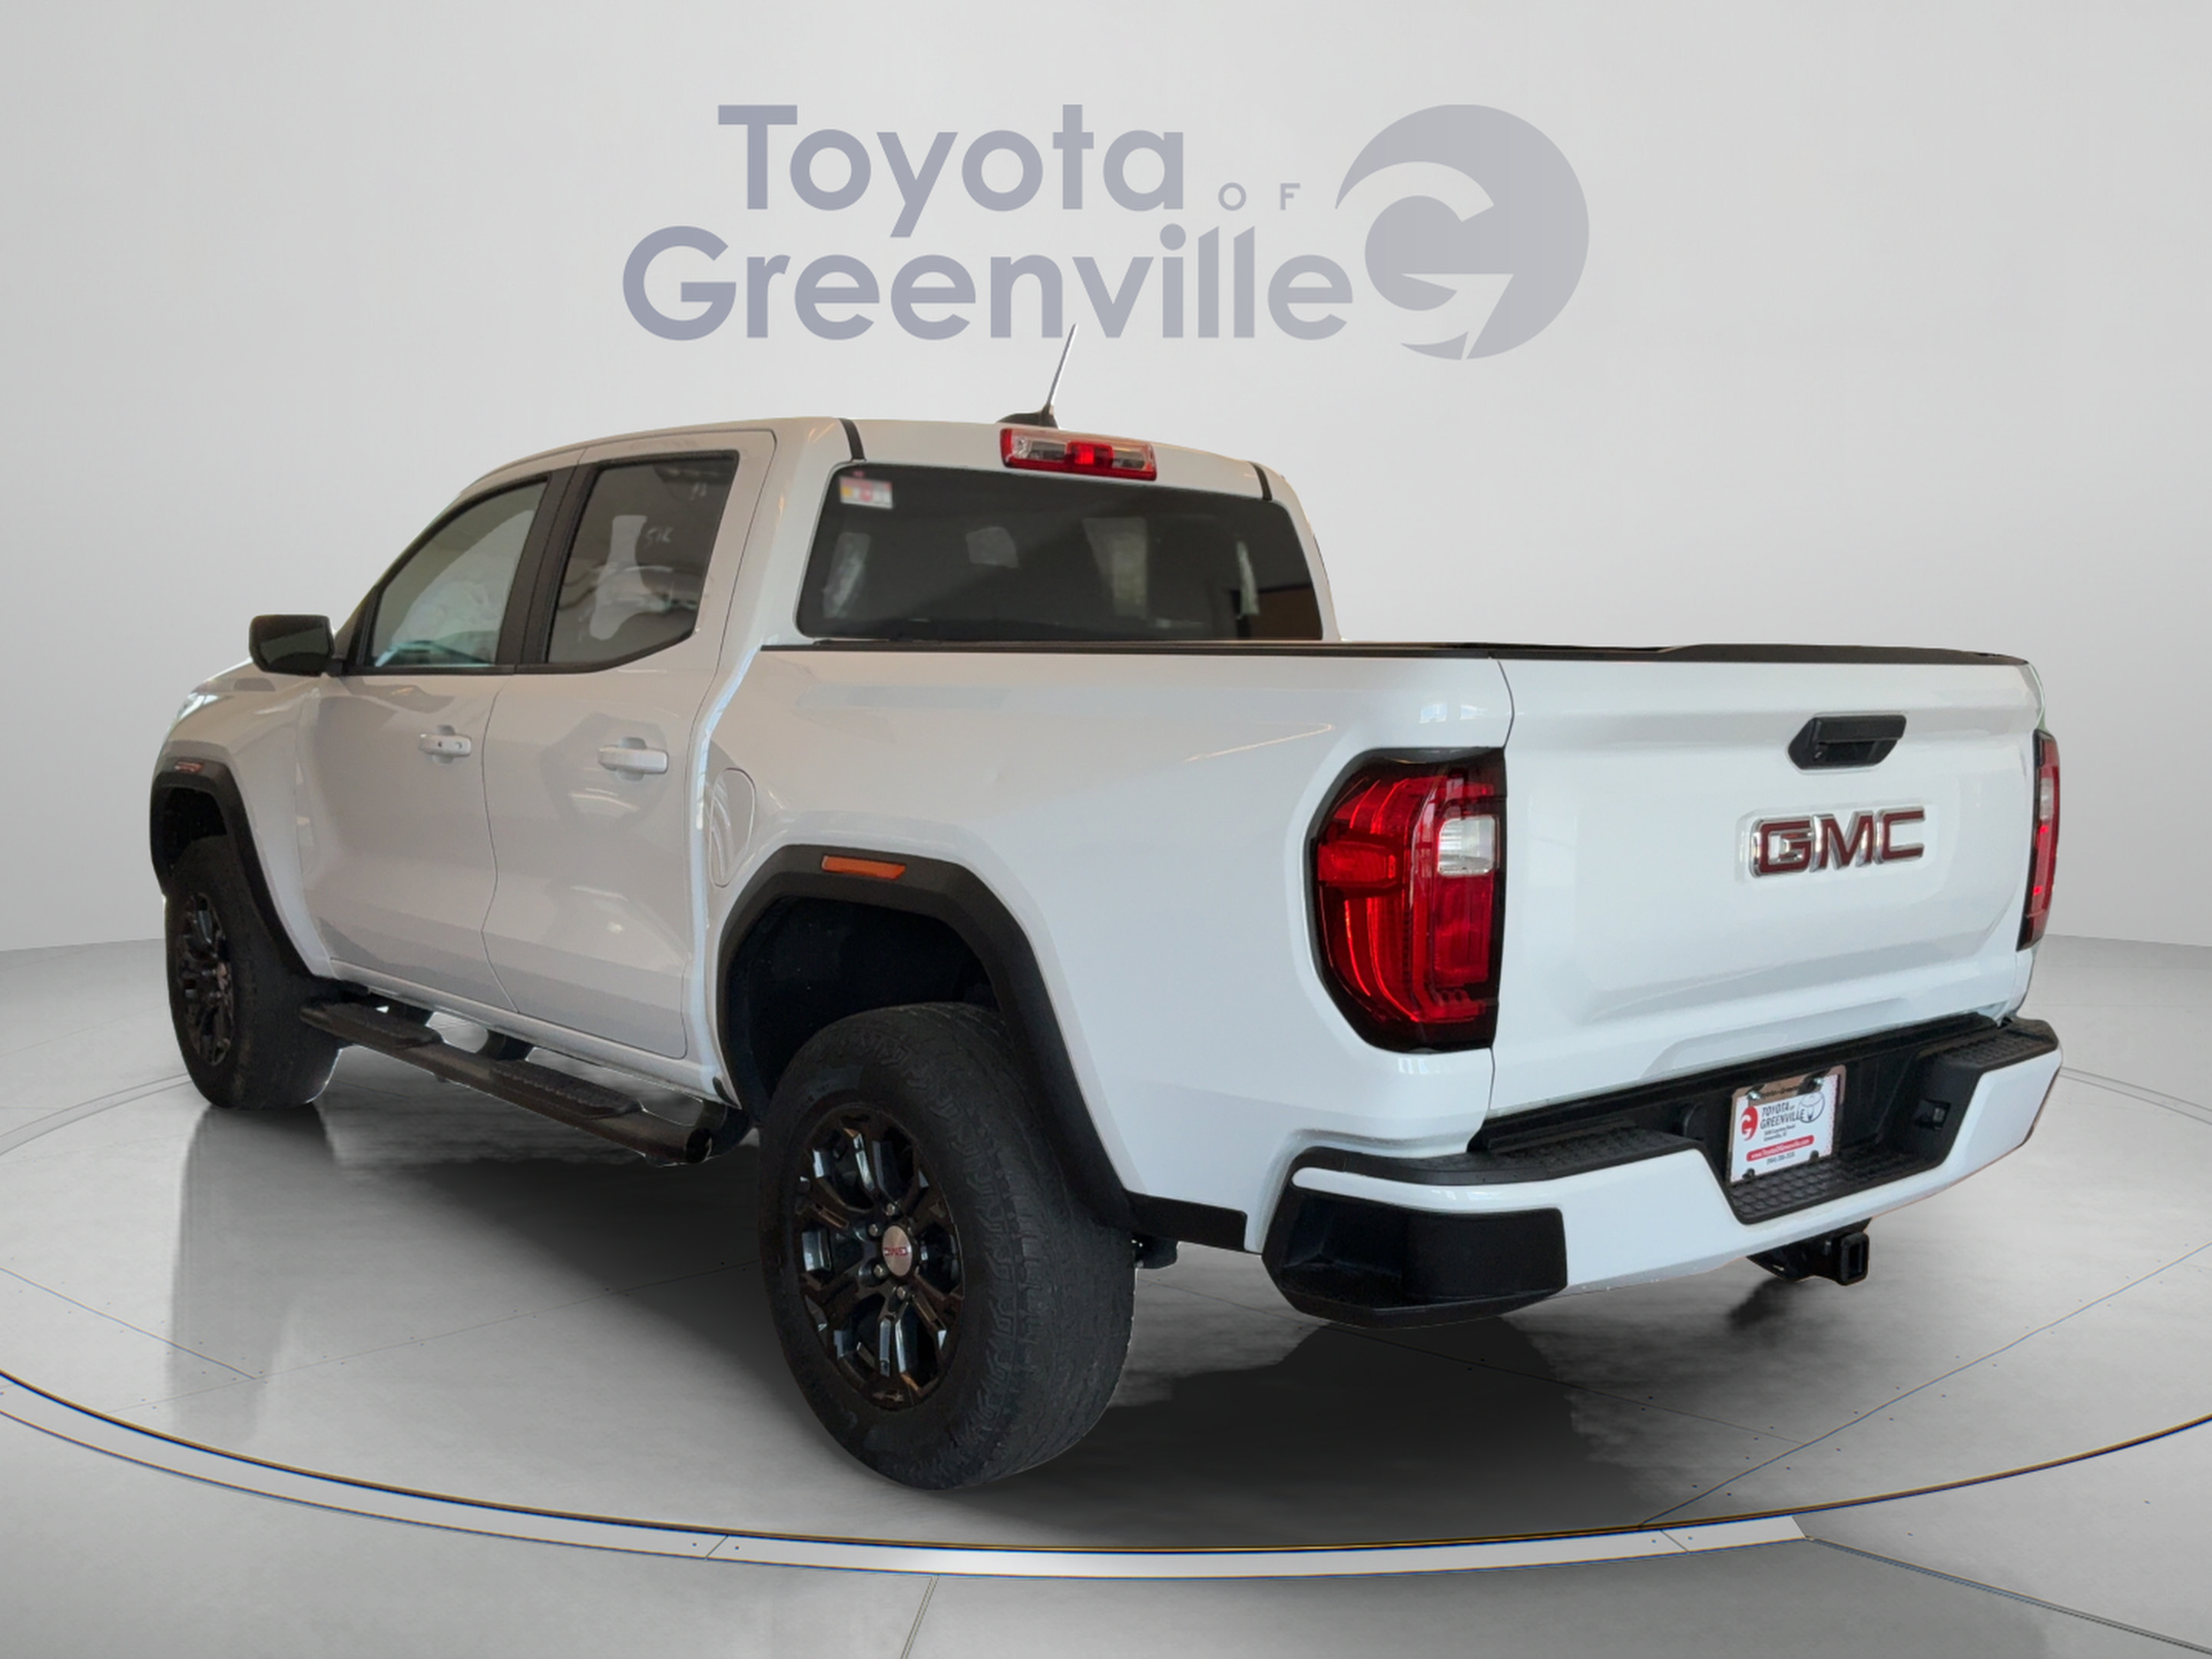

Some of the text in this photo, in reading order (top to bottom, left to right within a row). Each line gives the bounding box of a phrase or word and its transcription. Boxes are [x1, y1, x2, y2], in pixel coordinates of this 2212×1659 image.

[1749, 806, 1926, 878] GMC
[1760, 1108, 1806, 1130] GREENVILLE
[1761, 1101, 1790, 1118] TOYOTA
